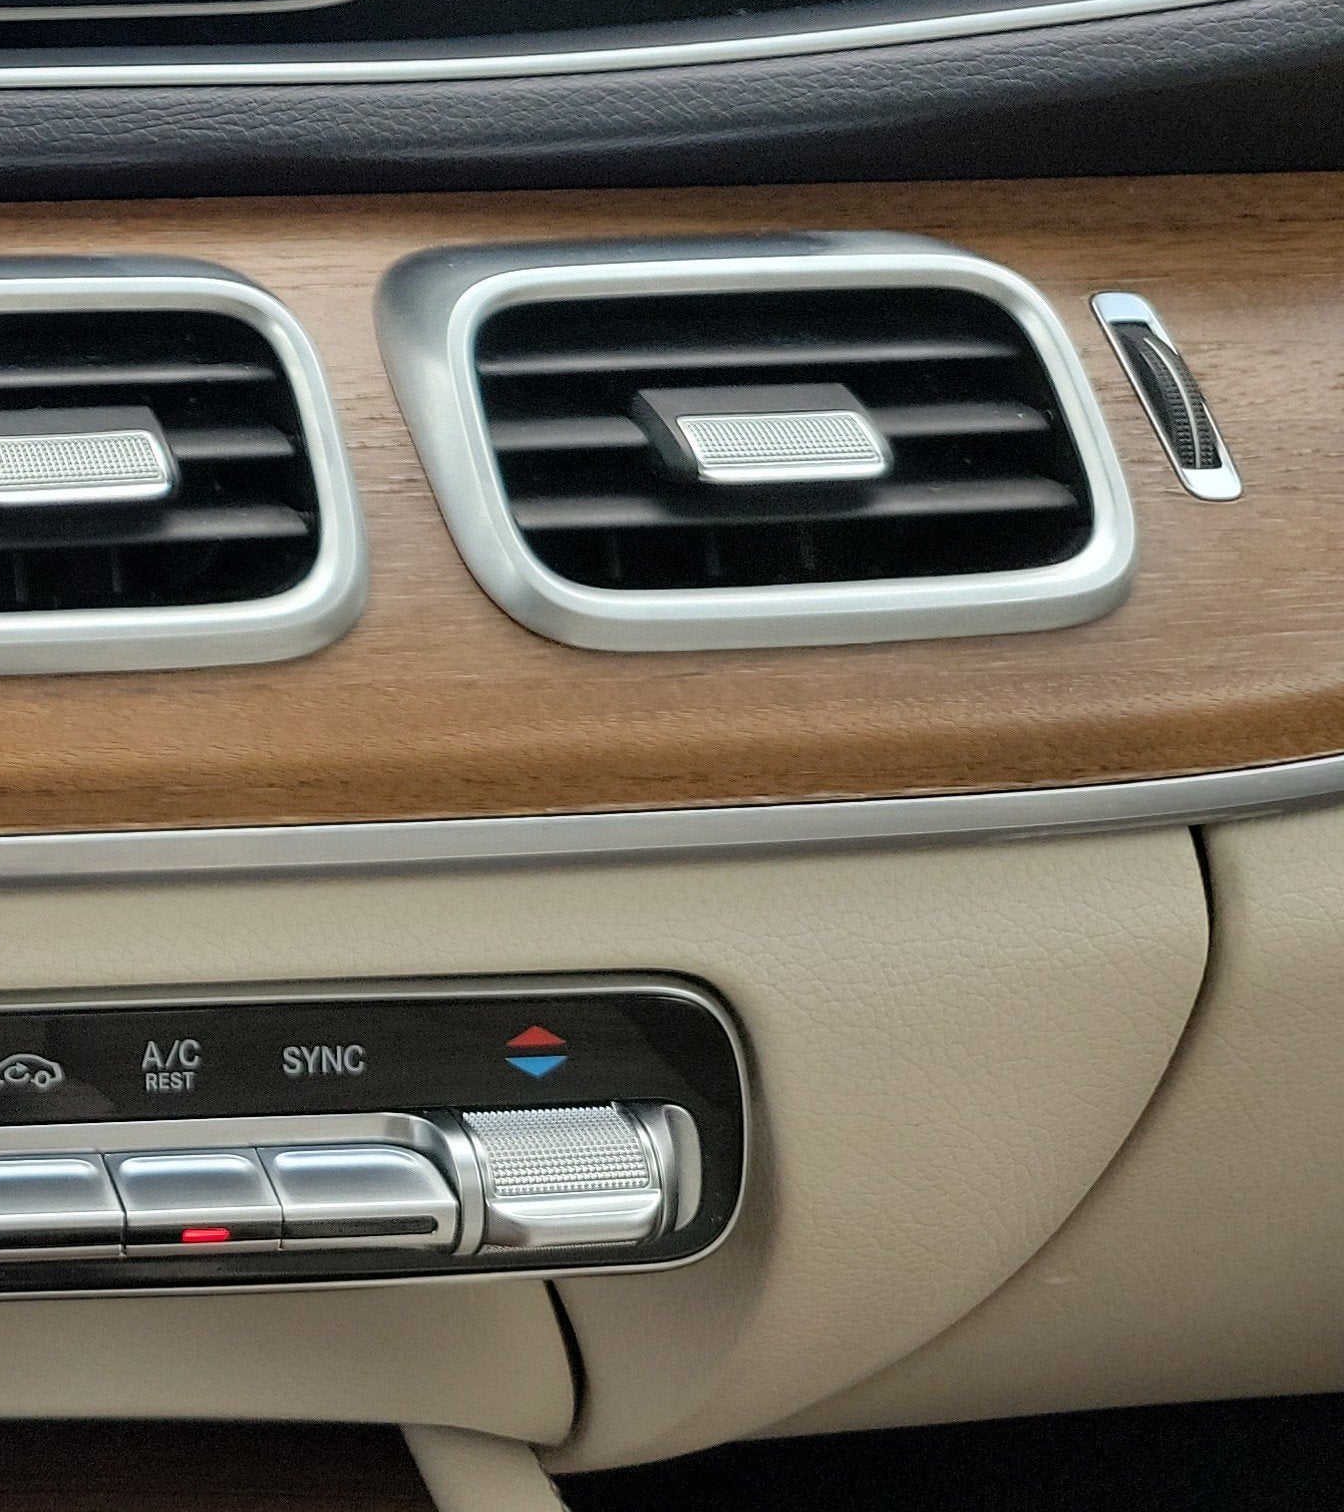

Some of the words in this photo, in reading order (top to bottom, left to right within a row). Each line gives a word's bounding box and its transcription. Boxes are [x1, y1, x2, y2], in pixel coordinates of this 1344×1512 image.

[142, 1038, 201, 1071] A/C
[282, 1044, 366, 1075] SYNC
[145, 1072, 195, 1091] REST
